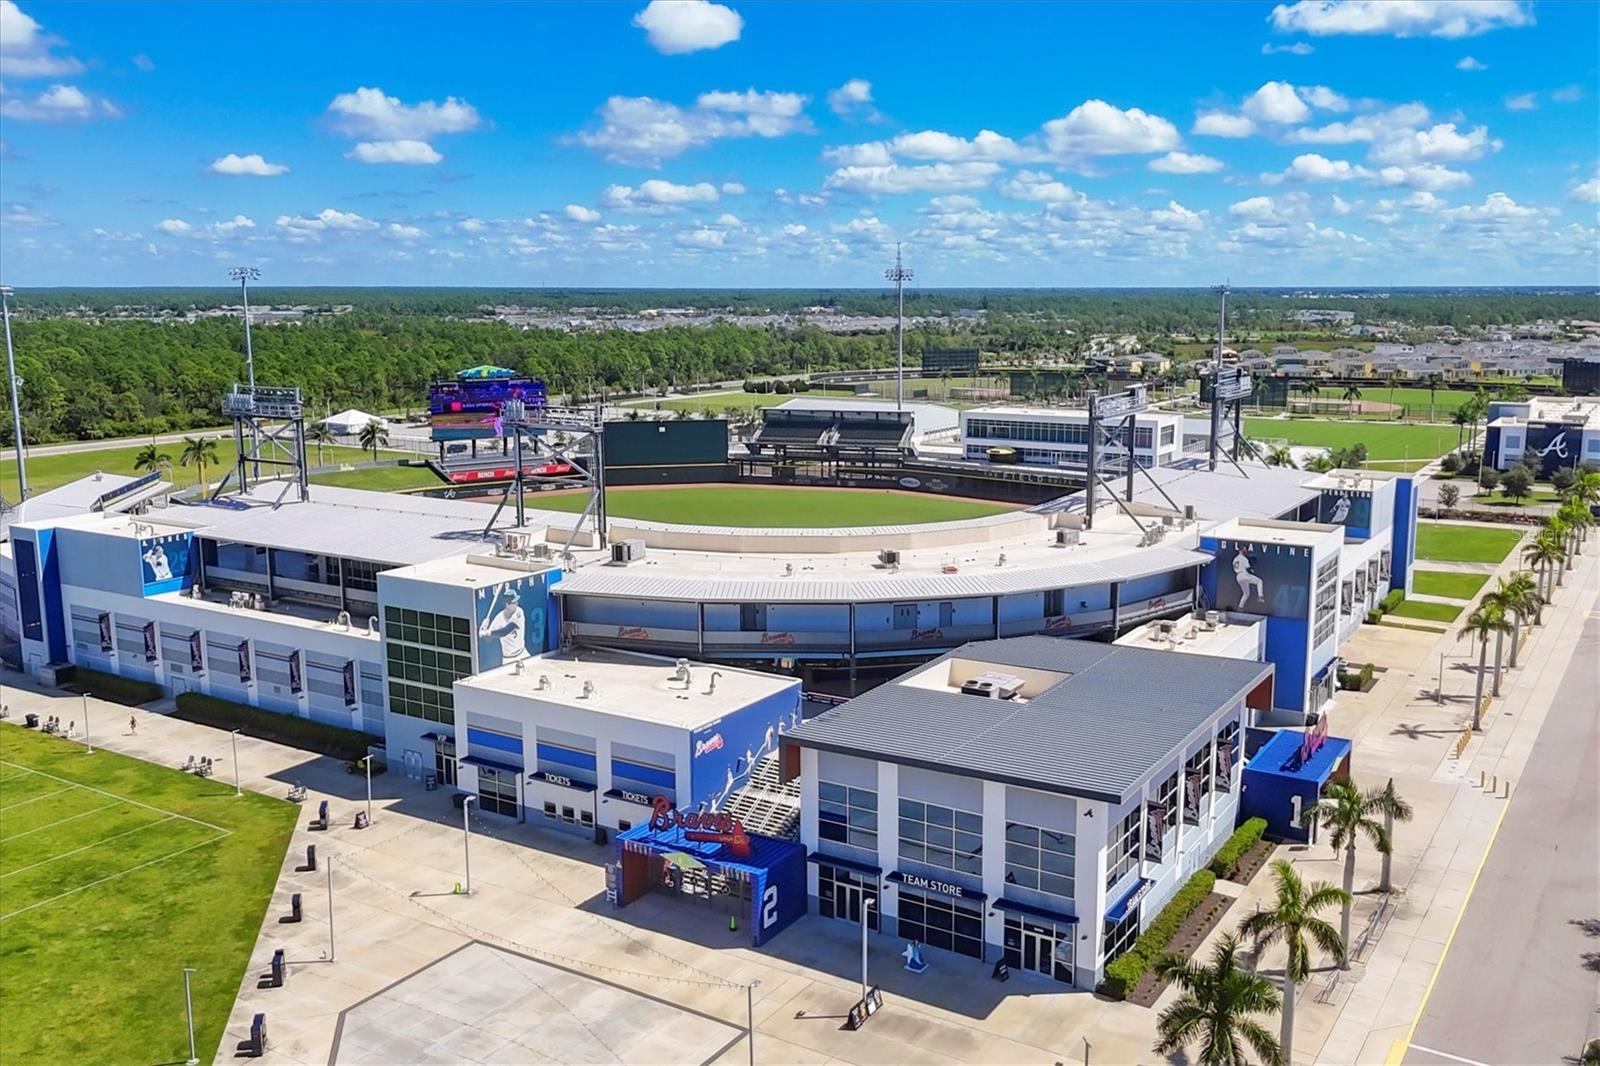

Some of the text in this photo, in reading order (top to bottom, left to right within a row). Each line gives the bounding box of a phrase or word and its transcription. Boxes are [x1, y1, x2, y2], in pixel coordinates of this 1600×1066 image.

[1220, 540, 1310, 557] GLAVINE
[478, 573, 546, 600] MURPHY
[1273, 583, 1307, 614] 47
[530, 607, 545, 645] 3
[437, 734, 447, 743] VIP
[544, 772, 571, 787] TICKETS
[621, 790, 649, 805] TICKETS
[648, 794, 733, 832] Braves
[1289, 795, 1303, 829] 1
[902, 873, 963, 898] TEAM STORE
[763, 884, 779, 930] 2
